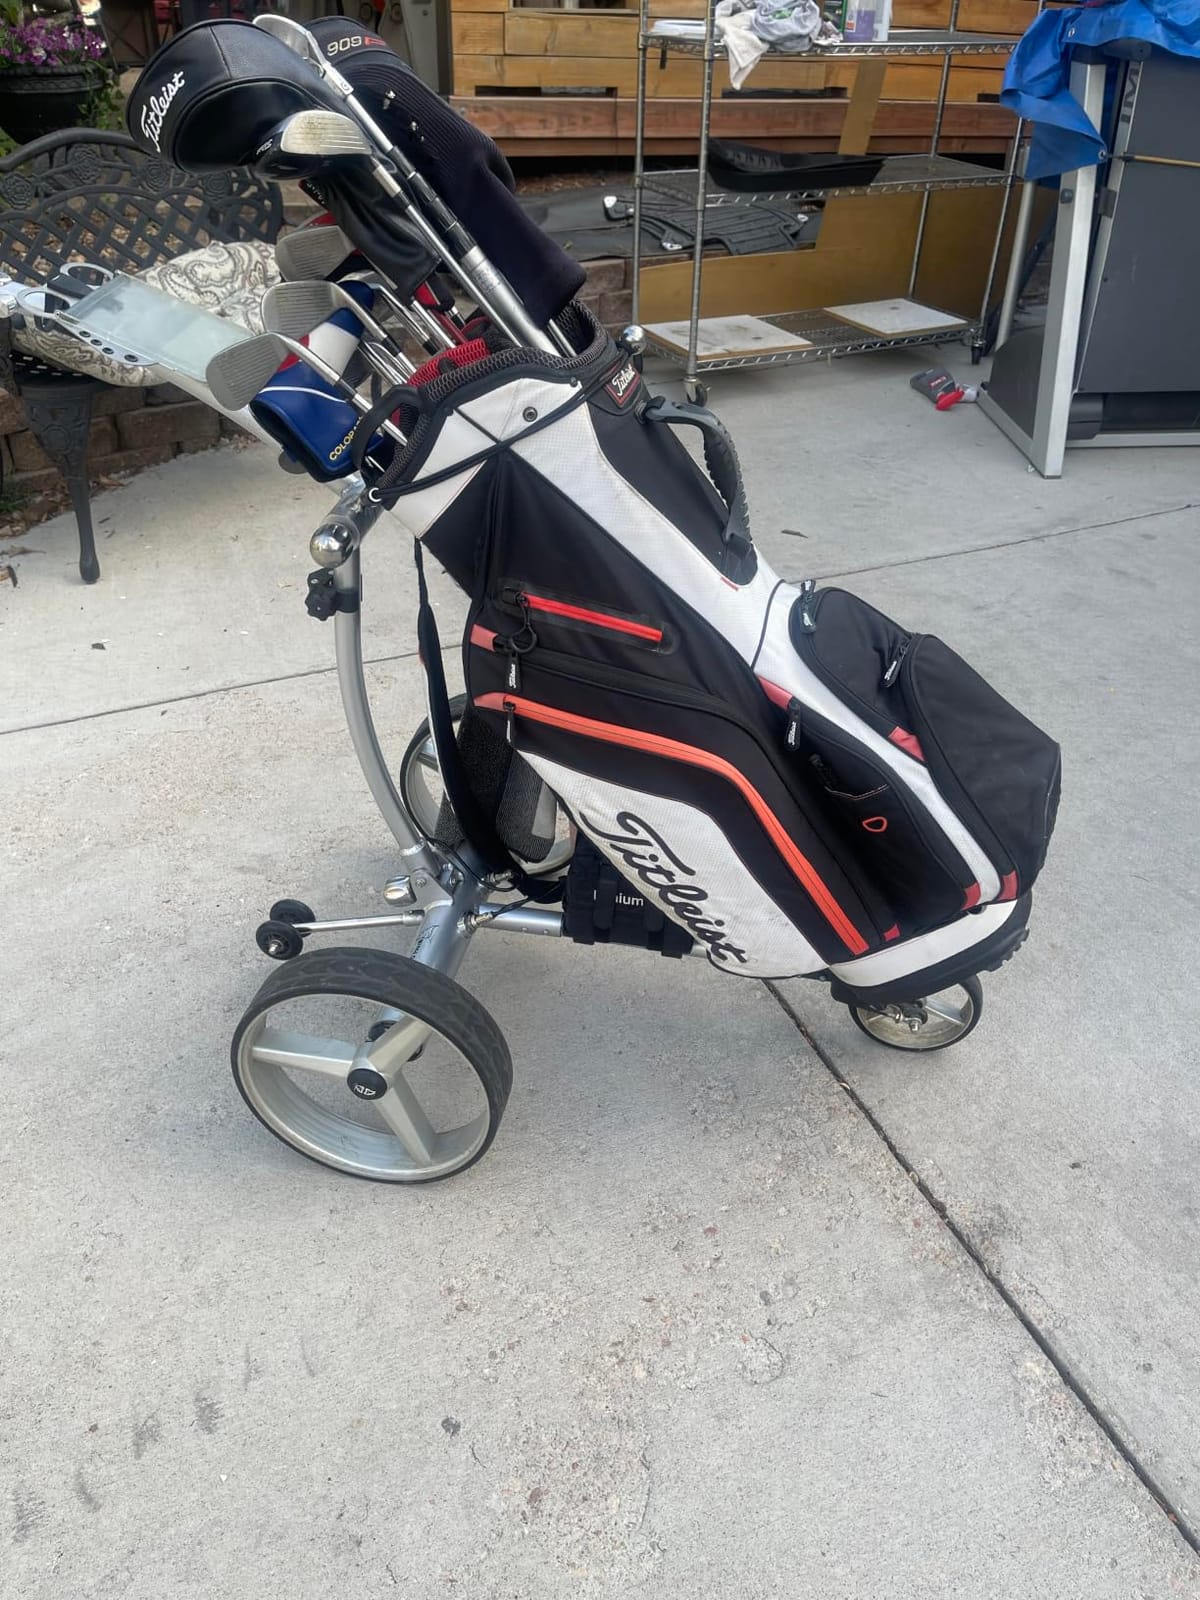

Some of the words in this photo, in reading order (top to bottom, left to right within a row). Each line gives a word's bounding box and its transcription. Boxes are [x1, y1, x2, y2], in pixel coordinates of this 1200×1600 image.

[327, 35, 362, 56] 909
[140, 71, 185, 153] Titleist
[578, 810, 747, 963] Titleist
